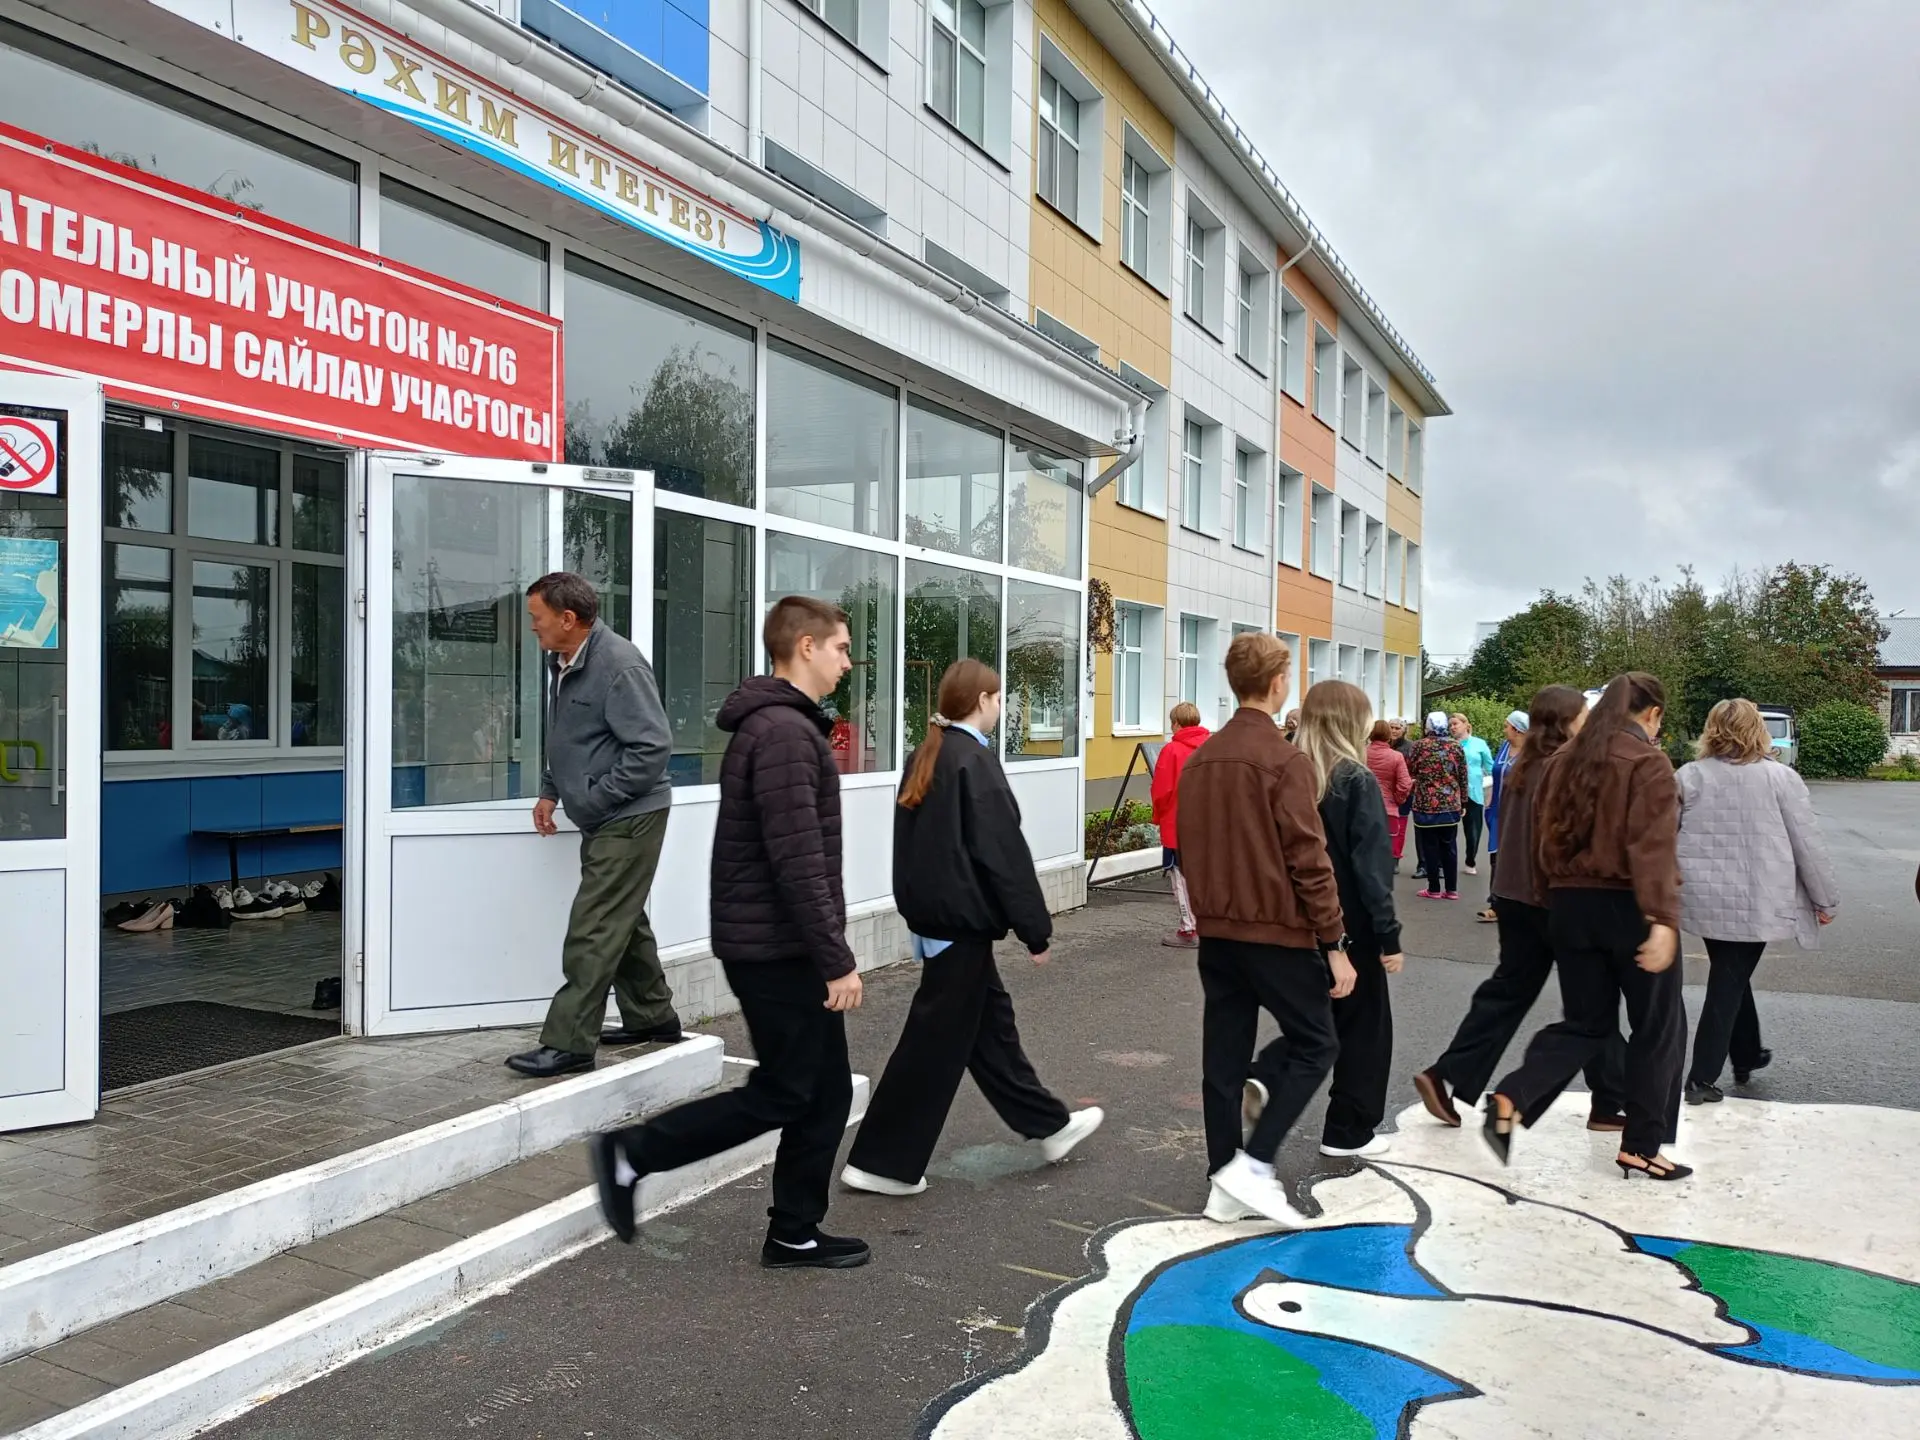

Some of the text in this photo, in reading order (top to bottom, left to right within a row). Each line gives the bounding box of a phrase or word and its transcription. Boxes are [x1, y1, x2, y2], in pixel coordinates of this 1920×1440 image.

[290, 0, 726, 249] РӘХИМ ИТЕГЕЗ!
[0, 268, 551, 449] ОМЕРЛЫ САЙЛАУ УЧАСТОГЫ
[265, 272, 430, 362] УЧАСТОК
[437, 326, 517, 386] №716
